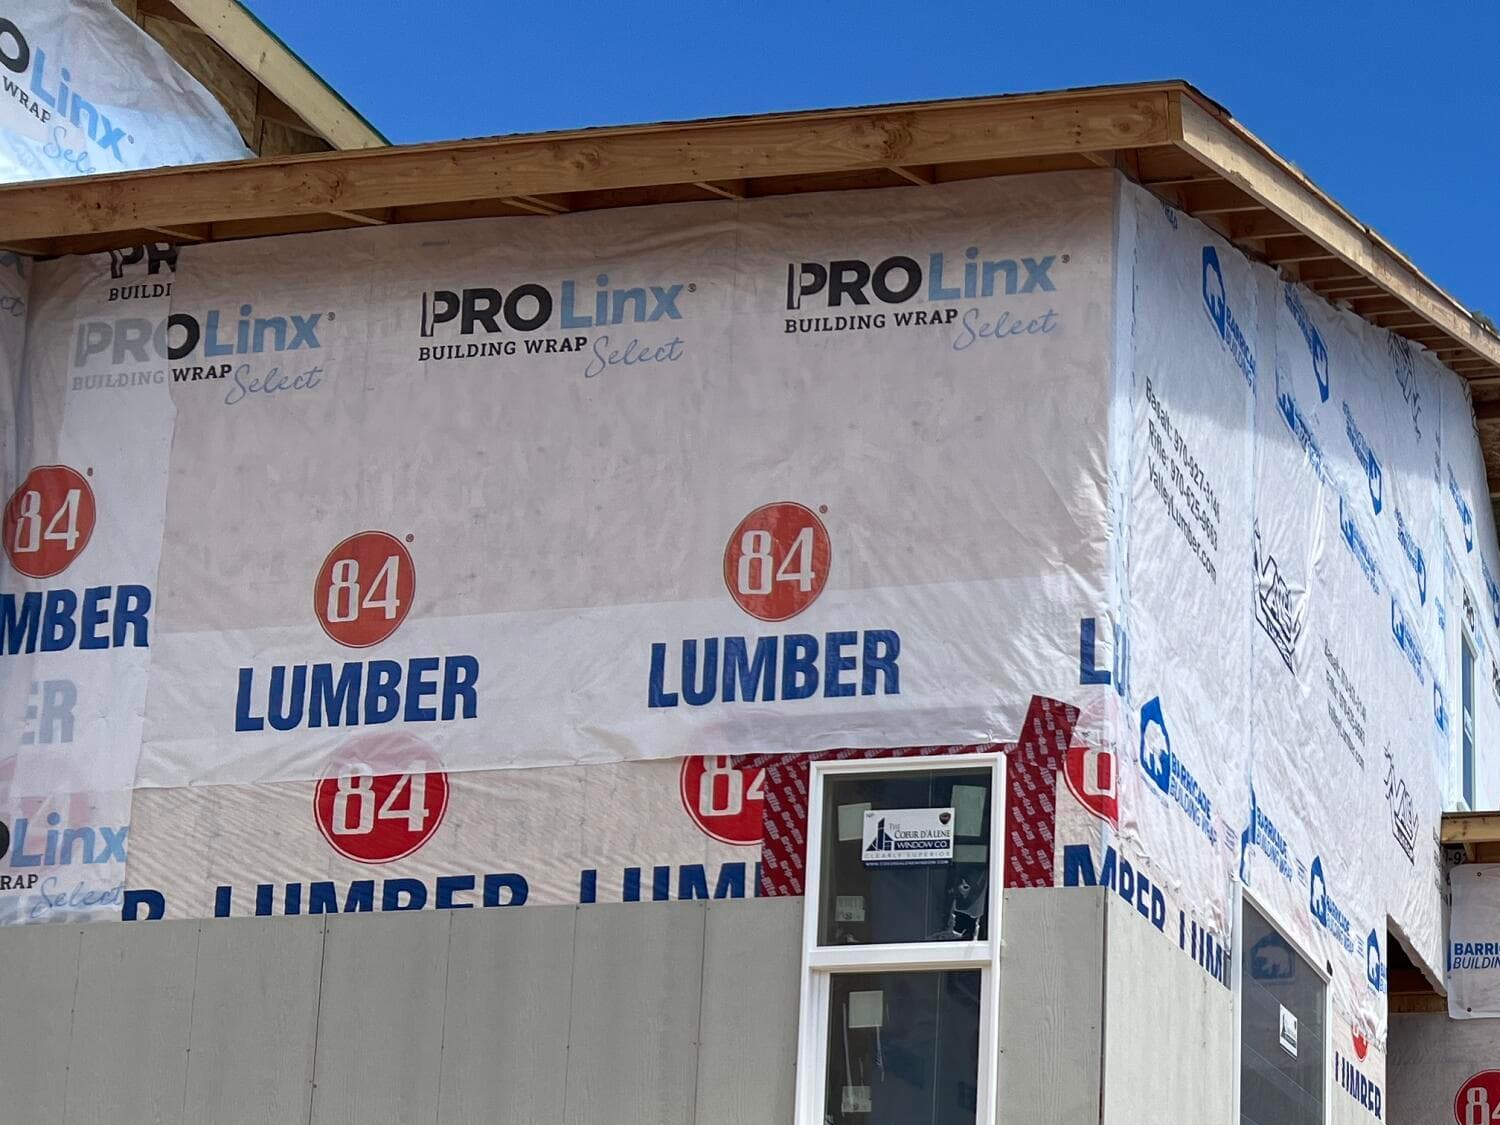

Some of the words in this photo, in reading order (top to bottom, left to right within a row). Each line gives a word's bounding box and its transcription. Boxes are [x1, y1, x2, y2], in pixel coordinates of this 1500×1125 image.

[2, 75, 51, 124] WRAP
[418, 340, 517, 362] BUILDING
[524, 335, 588, 355] WRAP
[584, 335, 685, 379] Select
[784, 313, 887, 334] BUILDING
[893, 308, 959, 327] WRAP
[953, 307, 1059, 351] Select
[71, 369, 165, 391] BUILDING
[172, 363, 233, 382] WRAP
[224, 363, 324, 405] Select
[13, 488, 82, 554] 84
[326, 554, 401, 624] 84
[737, 526, 816, 595] 84
[234, 654, 480, 733] LUMBER
[647, 628, 901, 709] LUMBER
[331, 760, 430, 836] 84
[0, 811, 129, 868] Linx
[896, 841, 933, 849] WINDOW
